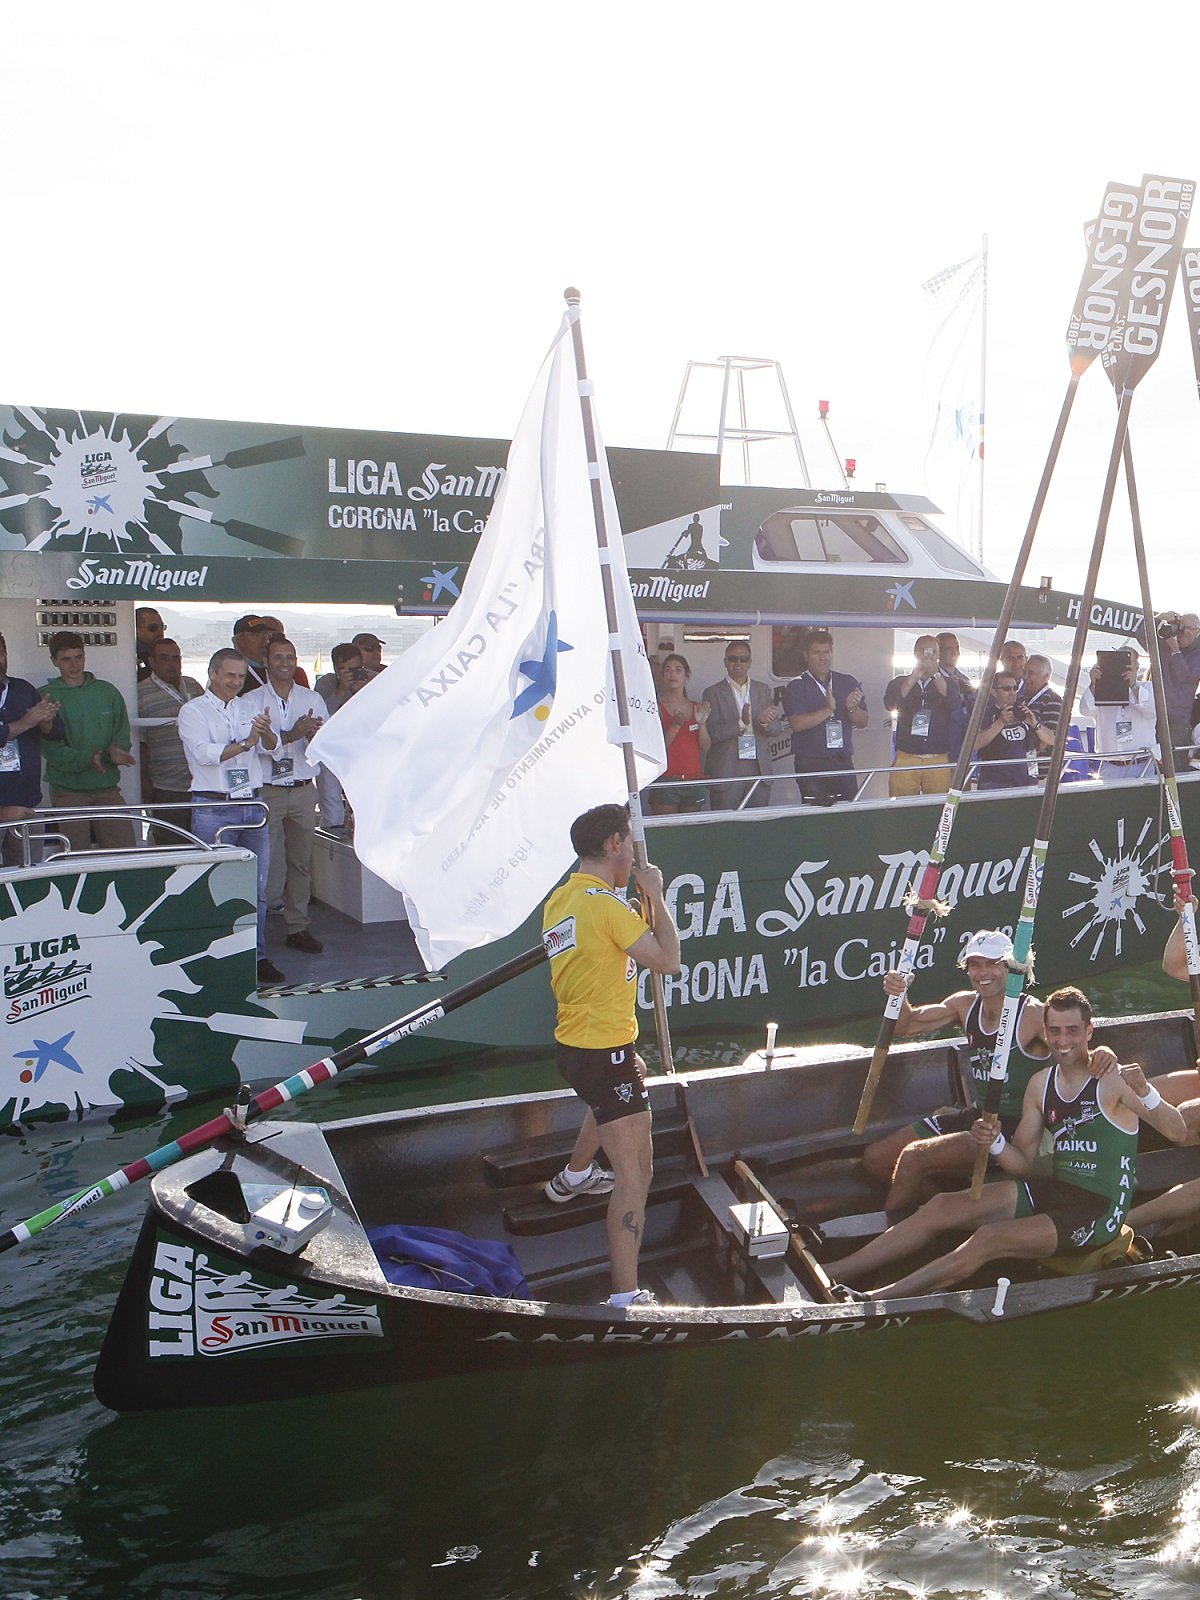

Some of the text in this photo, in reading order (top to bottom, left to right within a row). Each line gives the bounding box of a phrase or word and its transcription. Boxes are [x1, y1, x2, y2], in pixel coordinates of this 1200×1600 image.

[1179, 183, 1194, 219] 2000
[1078, 191, 1138, 350] GESNOR
[1124, 180, 1183, 355] GESNOR
[1067, 315, 1082, 346] 2000
[85, 452, 113, 464] LIGA
[328, 458, 403, 496] LIGA
[328, 504, 417, 531] CORONA
[1066, 598, 1145, 633] HGALUZ
[665, 870, 747, 941] GA
[14, 933, 81, 966] LIGA
[637, 953, 769, 1011] ORONA
[1056, 1140, 1098, 1153] KAIKU
[149, 1241, 195, 1357] LIGA
